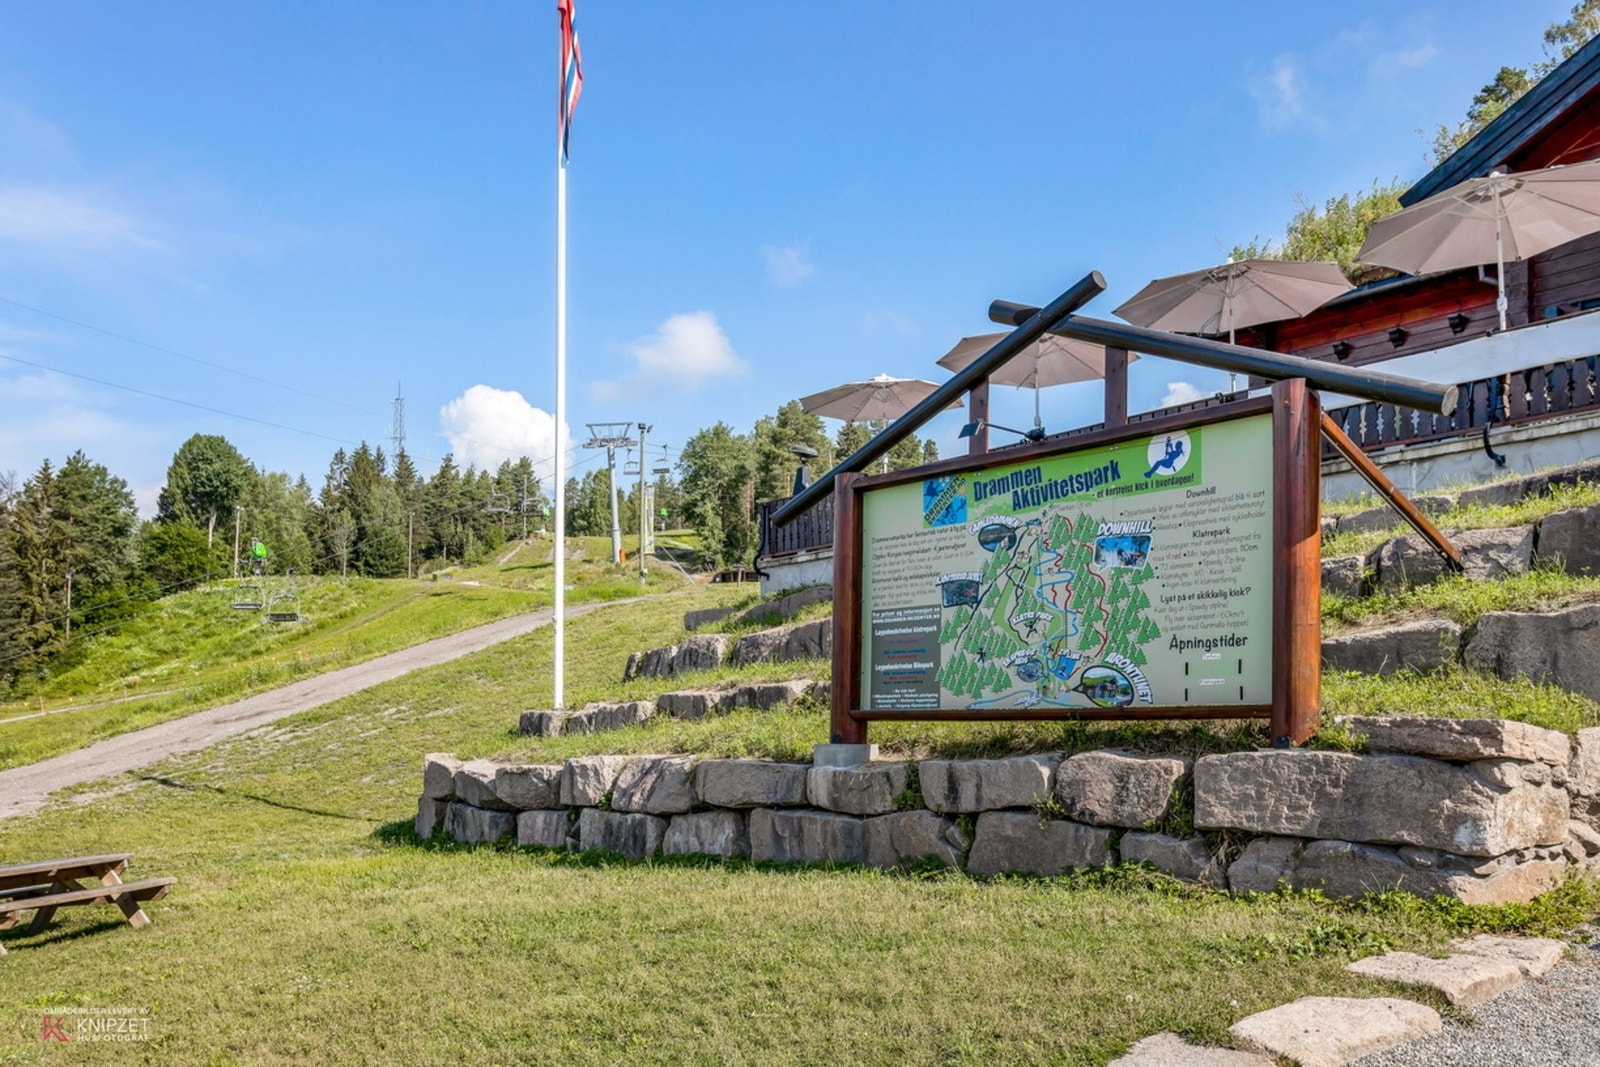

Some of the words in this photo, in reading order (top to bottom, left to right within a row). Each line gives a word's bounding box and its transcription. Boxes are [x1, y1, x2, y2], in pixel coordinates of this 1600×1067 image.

[973, 466, 1043, 502] Drammen
[1012, 459, 1121, 512] Aktivitetspark
[1096, 490, 1105, 499] et
[1105, 485, 1133, 497] kortreist
[1135, 482, 1149, 492] kick
[1155, 473, 1194, 488] hverdagen!
[1186, 486, 1217, 499] Downhill
[924, 475, 961, 521] DRAMMEN
[1234, 492, 1245, 501] blå
[1097, 520, 1153, 536] DOWNHILL
[1192, 526, 1231, 538] Klatrepark
[1160, 593, 1177, 605] Lyst
[1177, 593, 1187, 603] på
[1187, 592, 1196, 601] et
[1197, 589, 1228, 600] skikkelig
[1229, 586, 1251, 597] kick?
[1169, 632, 1248, 654] Åpningstider
